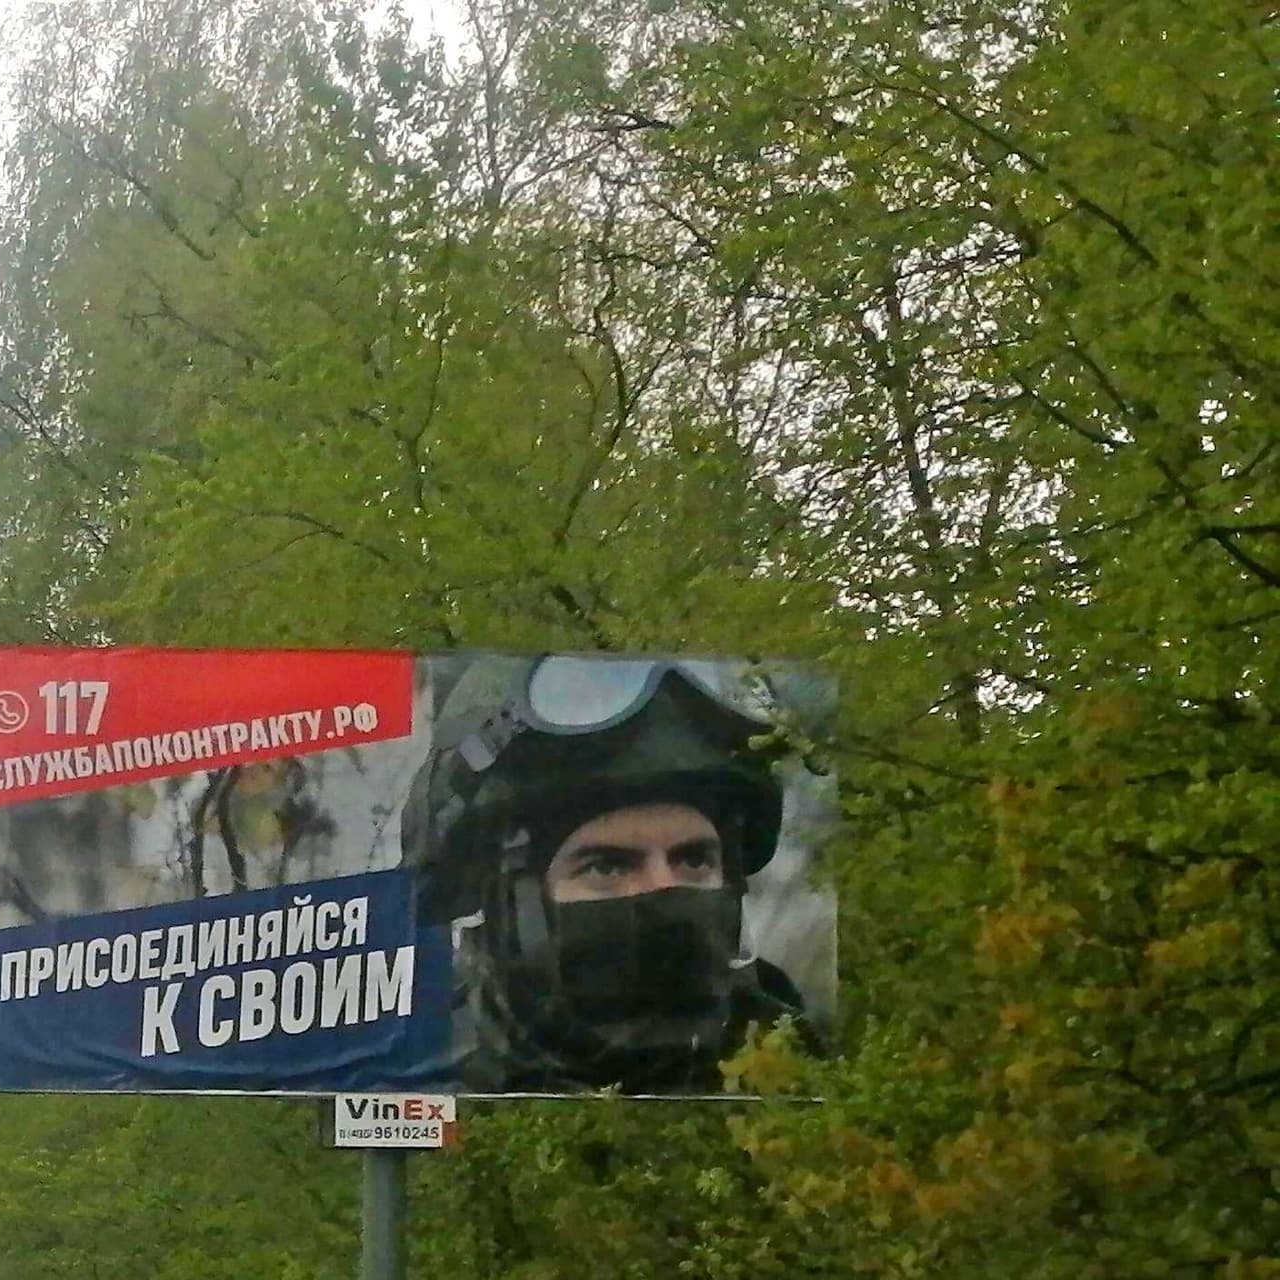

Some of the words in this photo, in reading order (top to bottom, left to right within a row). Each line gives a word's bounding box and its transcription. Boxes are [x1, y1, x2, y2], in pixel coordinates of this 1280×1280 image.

[40, 680, 110, 735] 117
[0, 894, 369, 1002] ПРИСОЕДИНЯЙСЯ
[140, 983, 180, 1058] К
[197, 945, 415, 1048] СВОИМ
[344, 1098, 445, 1121] VinEx
